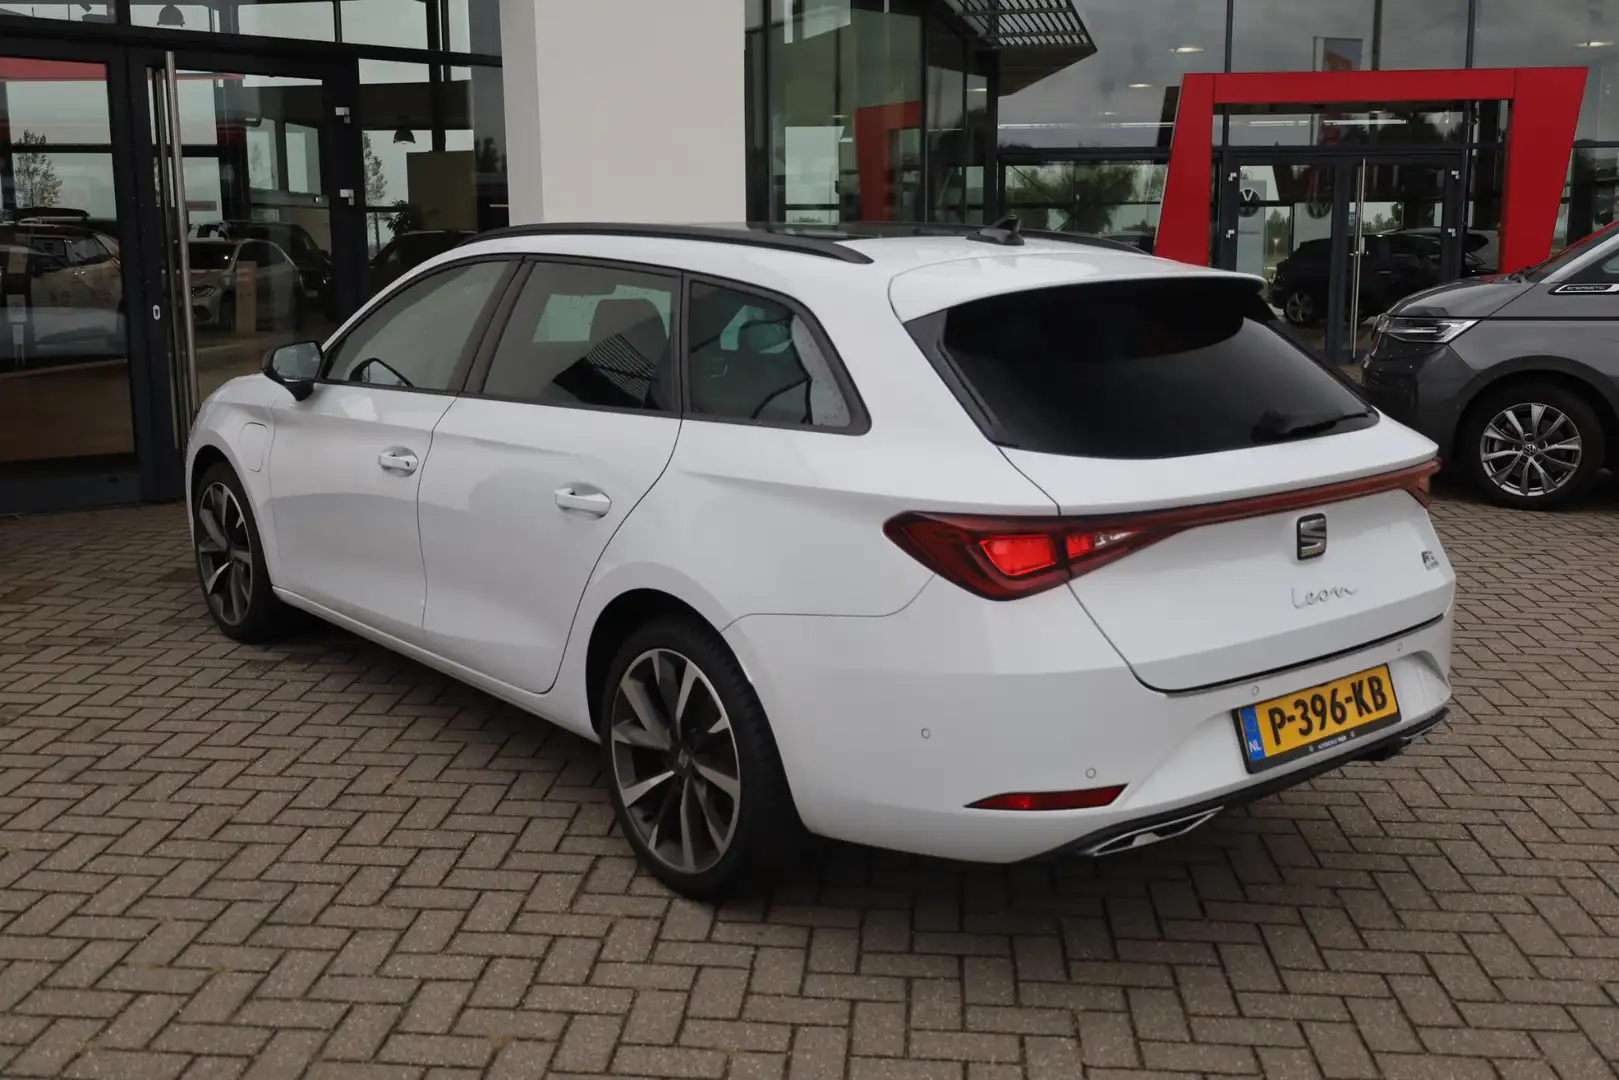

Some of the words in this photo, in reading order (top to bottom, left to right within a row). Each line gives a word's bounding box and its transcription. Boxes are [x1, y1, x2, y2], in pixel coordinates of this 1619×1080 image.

[1291, 586, 1357, 609] Leon
[1268, 675, 1387, 746] P-396-KB
[1248, 740, 1262, 753] NL
